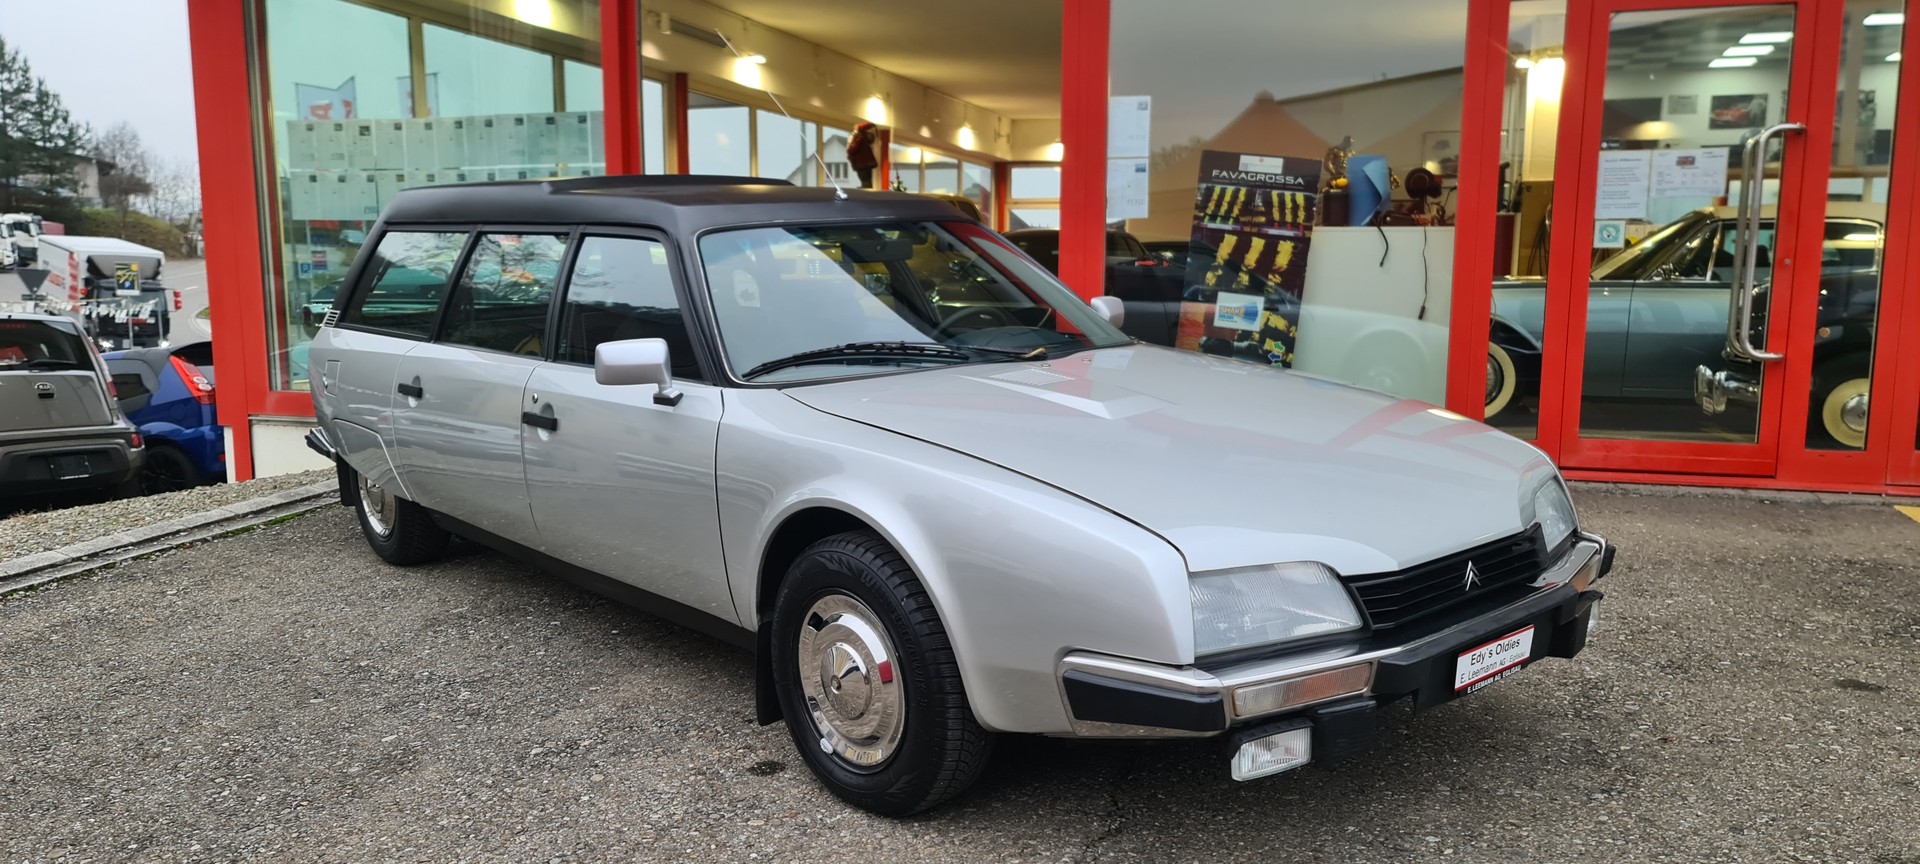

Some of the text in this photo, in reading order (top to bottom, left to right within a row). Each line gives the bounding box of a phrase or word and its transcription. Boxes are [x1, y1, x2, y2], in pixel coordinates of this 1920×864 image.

[1212, 169, 1304, 185] FAVAGROSSA
[1495, 639, 1520, 655] Oldies
[1468, 661, 1497, 681] Leemann
[1499, 657, 1506, 666] AG
